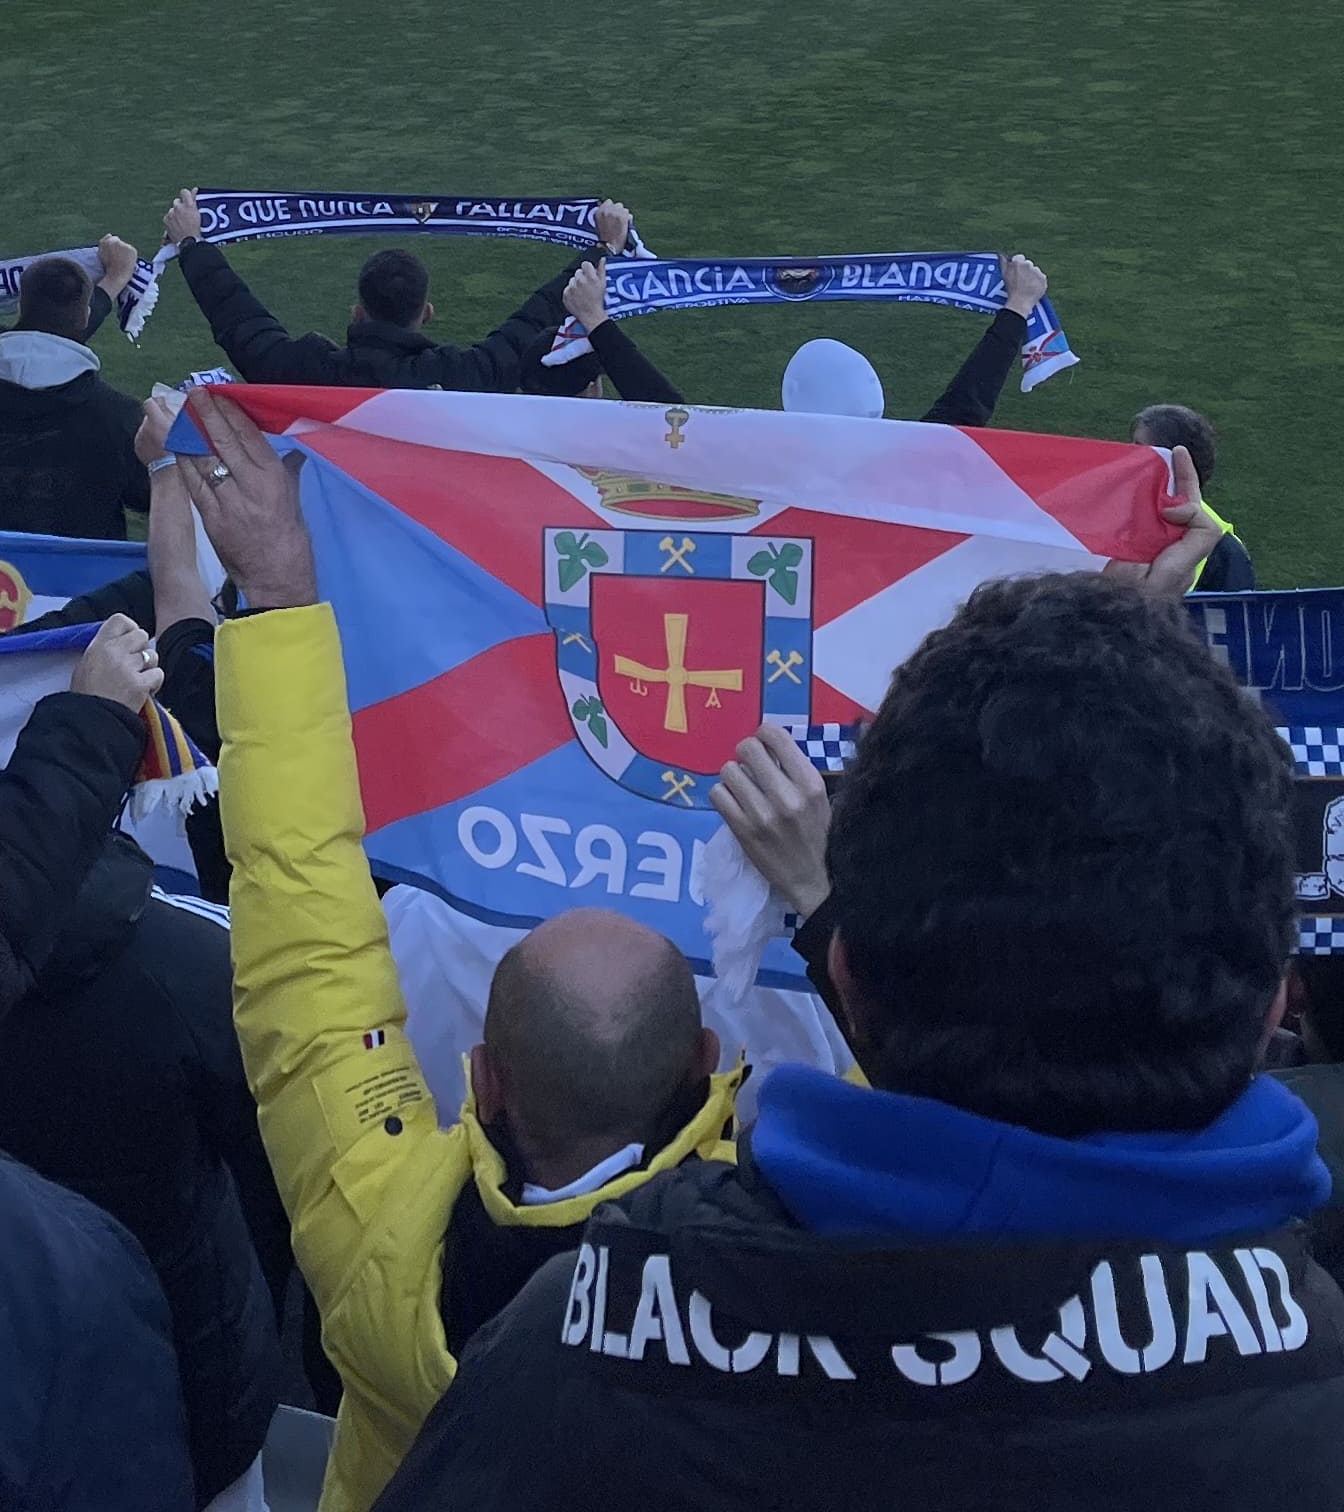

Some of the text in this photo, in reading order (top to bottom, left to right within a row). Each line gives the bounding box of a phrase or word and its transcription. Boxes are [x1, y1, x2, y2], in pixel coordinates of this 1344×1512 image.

[198, 203, 230, 233] OS
[238, 199, 291, 223] QUE
[560, 1243, 1309, 1386] BLAC QUAD
